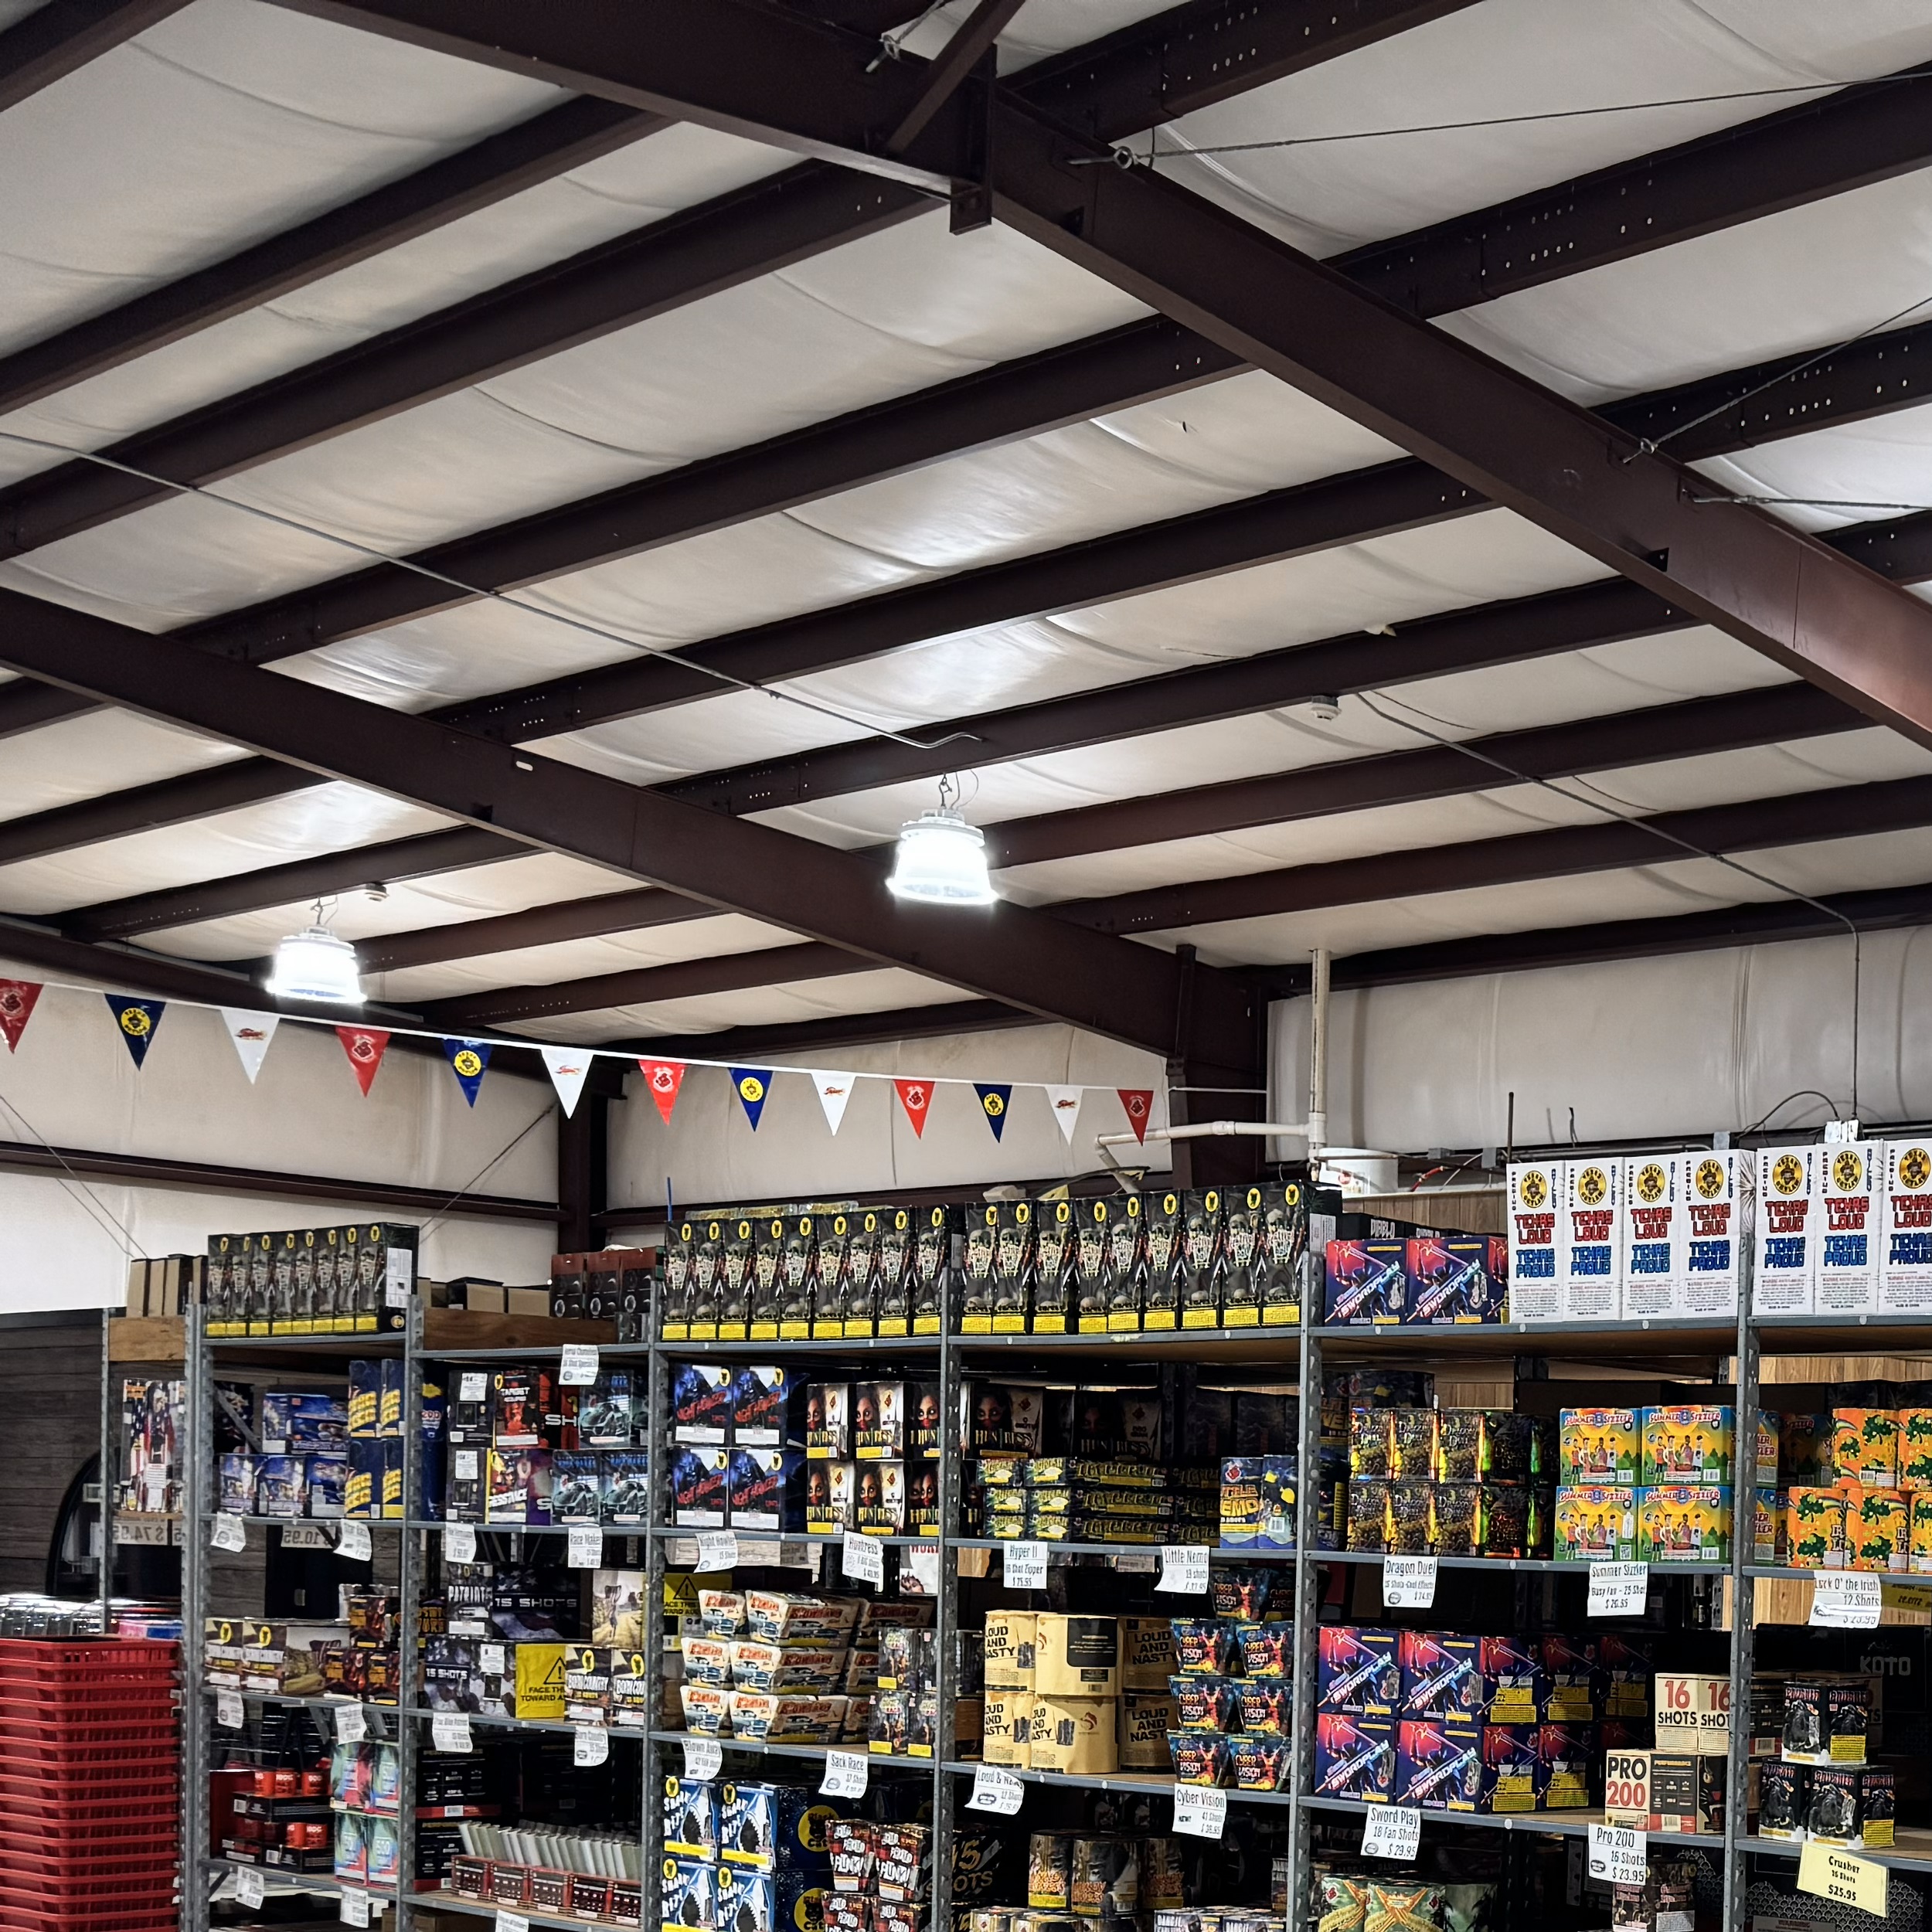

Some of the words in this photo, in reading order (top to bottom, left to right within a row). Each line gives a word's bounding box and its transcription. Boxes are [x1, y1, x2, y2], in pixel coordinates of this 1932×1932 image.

[1765, 1199, 1808, 1216] TEXAS
[1824, 1196, 1869, 1214] TEXAS
[1891, 1194, 1932, 1212] TEXAS
[1571, 1210, 1613, 1226] TEXAS
[1631, 1206, 1672, 1223] TEXAS
[1689, 1203, 1731, 1220] TEXAS
[1515, 1213, 1555, 1229] TEXAS
[1692, 1219, 1726, 1236] LOUD
[1769, 1216, 1804, 1233] LOUD
[1828, 1213, 1865, 1230] LOUD
[1894, 1212, 1931, 1228] LOUD
[1519, 1229, 1552, 1244] LOUD
[1574, 1226, 1609, 1242] LOUD
[1635, 1223, 1668, 1240] LOUD
[1689, 1240, 1730, 1257] TEXAS
[1766, 1236, 1805, 1253] TEXAS
[1824, 1235, 1867, 1252] TEXAS
[1890, 1233, 1932, 1250] TEXAS
[1515, 1249, 1554, 1264] TEXAS
[1571, 1246, 1611, 1261] TEXAS
[1632, 1243, 1670, 1259] TEXAS
[1824, 1250, 1867, 1267] PROUD
[1889, 1248, 1932, 1265] PROUD
[1571, 1260, 1611, 1276] PROUD
[1631, 1258, 1670, 1274] PROUD
[1689, 1255, 1730, 1271] PROUD
[1764, 1252, 1804, 1268] PROUD
[1516, 1263, 1555, 1278] PROUD
[1219, 1498, 1260, 1517] EMO
[849, 1536, 879, 1556] Huntress
[1010, 1545, 1030, 1561] Hyper
[1165, 1548, 1185, 1563] Little
[1187, 1550, 1208, 1563] Nemo
[1386, 1560, 1414, 1577] Dragon
[1417, 1560, 1436, 1575] Duel
[1592, 1566, 1621, 1577] Summer
[1624, 1564, 1646, 1577] Sizzler
[1845, 1578, 1858, 1590] the
[1860, 1579, 1879, 1591] Irish
[448, 1585, 485, 1603] PATRIOT
[1855, 1594, 1879, 1607] Shots
[495, 1598, 512, 1607] 15
[519, 1598, 577, 1607] SHOTS
[986, 1626, 1009, 1638] OUD
[1134, 1631, 1172, 1643] LOUD
[987, 1638, 1006, 1647] AND
[1140, 1642, 1168, 1654] AND
[1132, 1652, 1176, 1665] NASTY
[1859, 1655, 1911, 1675] KOTO
[426, 1668, 436, 1677] 15
[438, 1668, 468, 1680] SHOTS
[1331, 1651, 1391, 1704] SWORDPLAY
[1413, 1658, 1472, 1710] SWORDPLAY
[1665, 1680, 1690, 1709] 16
[1709, 1682, 1730, 1712] 16
[1132, 1708, 1168, 1720] LOUD
[1658, 1711, 1697, 1726] SHOTS
[1701, 1713, 1730, 1728] SHOT
[985, 1724, 1010, 1735] ASTY
[1138, 1719, 1166, 1730] AND
[1032, 1728, 1052, 1740] ASTY
[1130, 1730, 1167, 1742] NAST
[832, 1754, 846, 1768] Sack
[848, 1756, 865, 1771] Race
[1328, 1739, 1389, 1790] SWORDPLAY
[1607, 1757, 1647, 1781] PRO
[1412, 1747, 1477, 1798] SWORDPLAY
[1177, 1789, 1199, 1805] Cyber
[1201, 1792, 1224, 1808] Vision
[1607, 1781, 1646, 1808] 200
[1371, 1808, 1398, 1824] Sword
[1400, 1811, 1418, 1828] Play
[1374, 1826, 1382, 1837] 18
[1383, 1827, 1396, 1839] Fan
[1398, 1828, 1419, 1842] Shots
[1597, 1828, 1612, 1842] Pro
[1617, 1830, 1634, 1848] 200
[808, 1838, 827, 1848] Cat
[1611, 1851, 1619, 1862] 16
[1621, 1852, 1645, 1866] Shots
[1828, 1855, 1860, 1873] Crusher
[1828, 1884, 1857, 1901] $25.95
